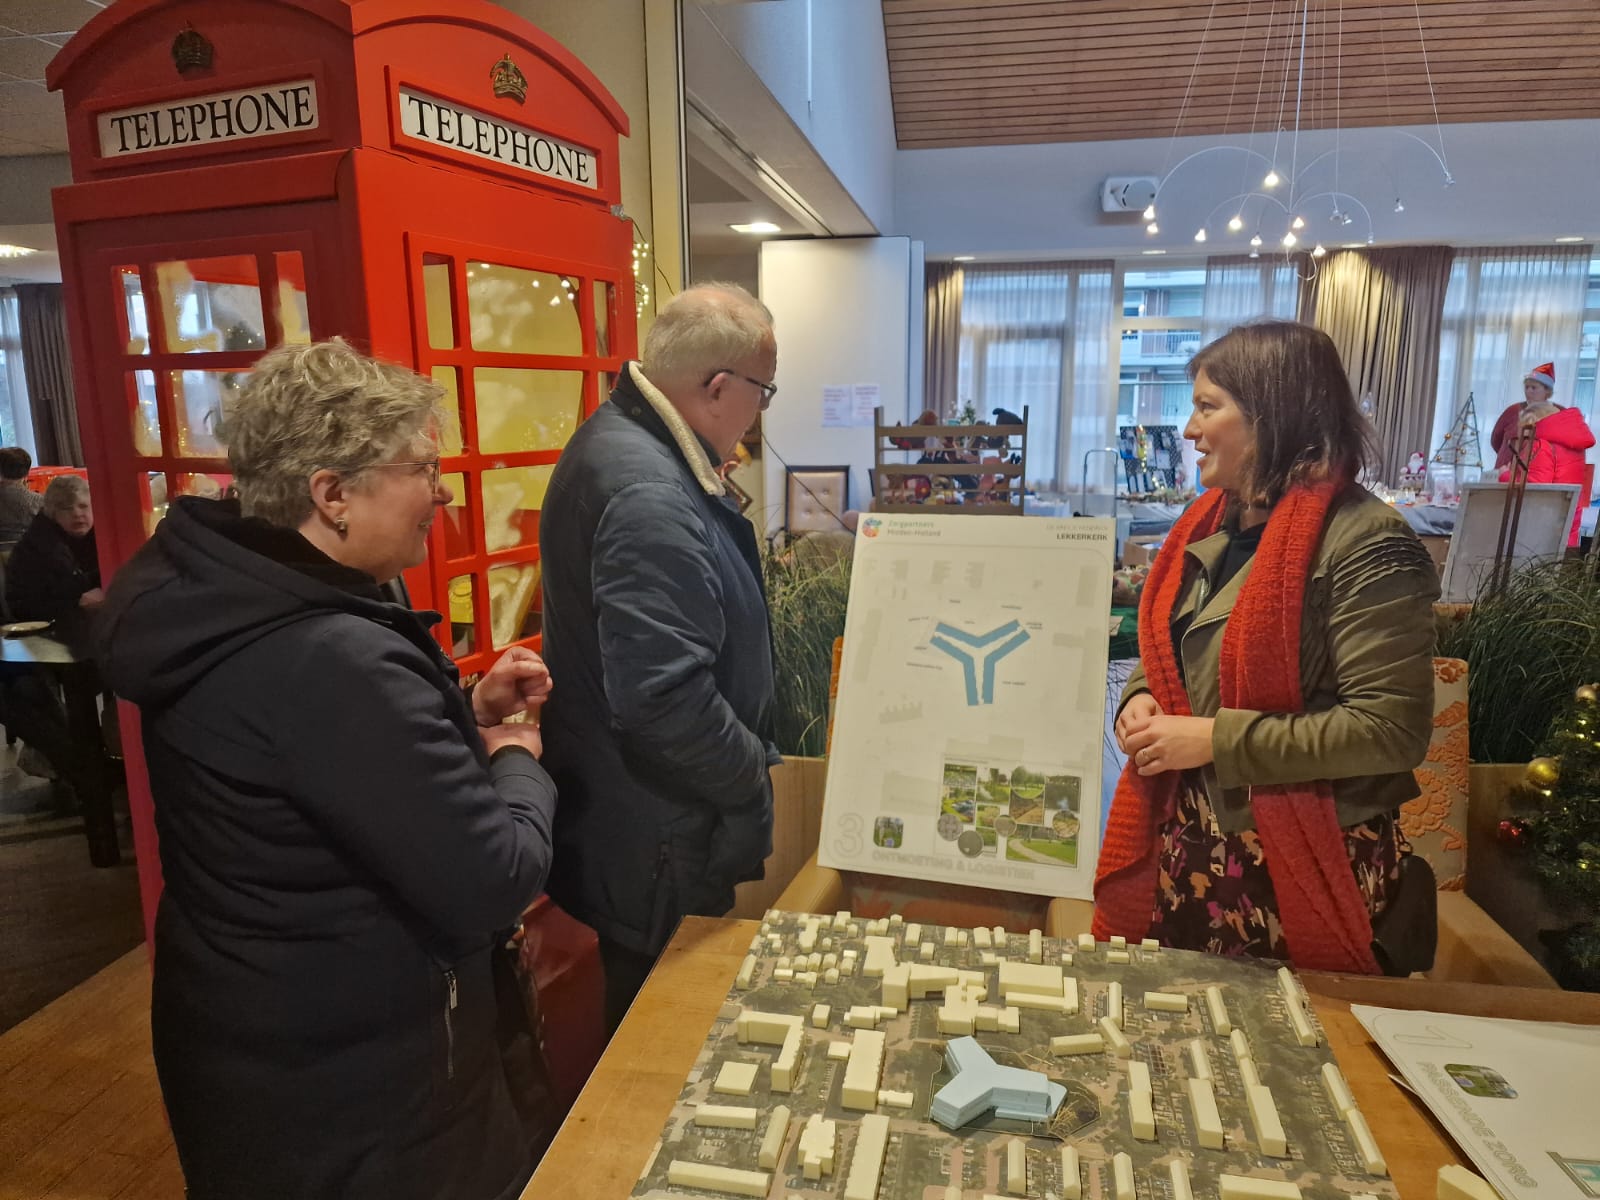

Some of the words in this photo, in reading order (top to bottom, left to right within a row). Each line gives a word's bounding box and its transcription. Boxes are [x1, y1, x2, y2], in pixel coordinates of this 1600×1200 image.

[111, 86, 315, 153] TELEPHONE
[408, 95, 590, 184] TELEPHONE
[1056, 533, 1108, 541] LEKKERKERK
[833, 812, 865, 858] 3
[1482, 1139, 1539, 1189] ZORG
